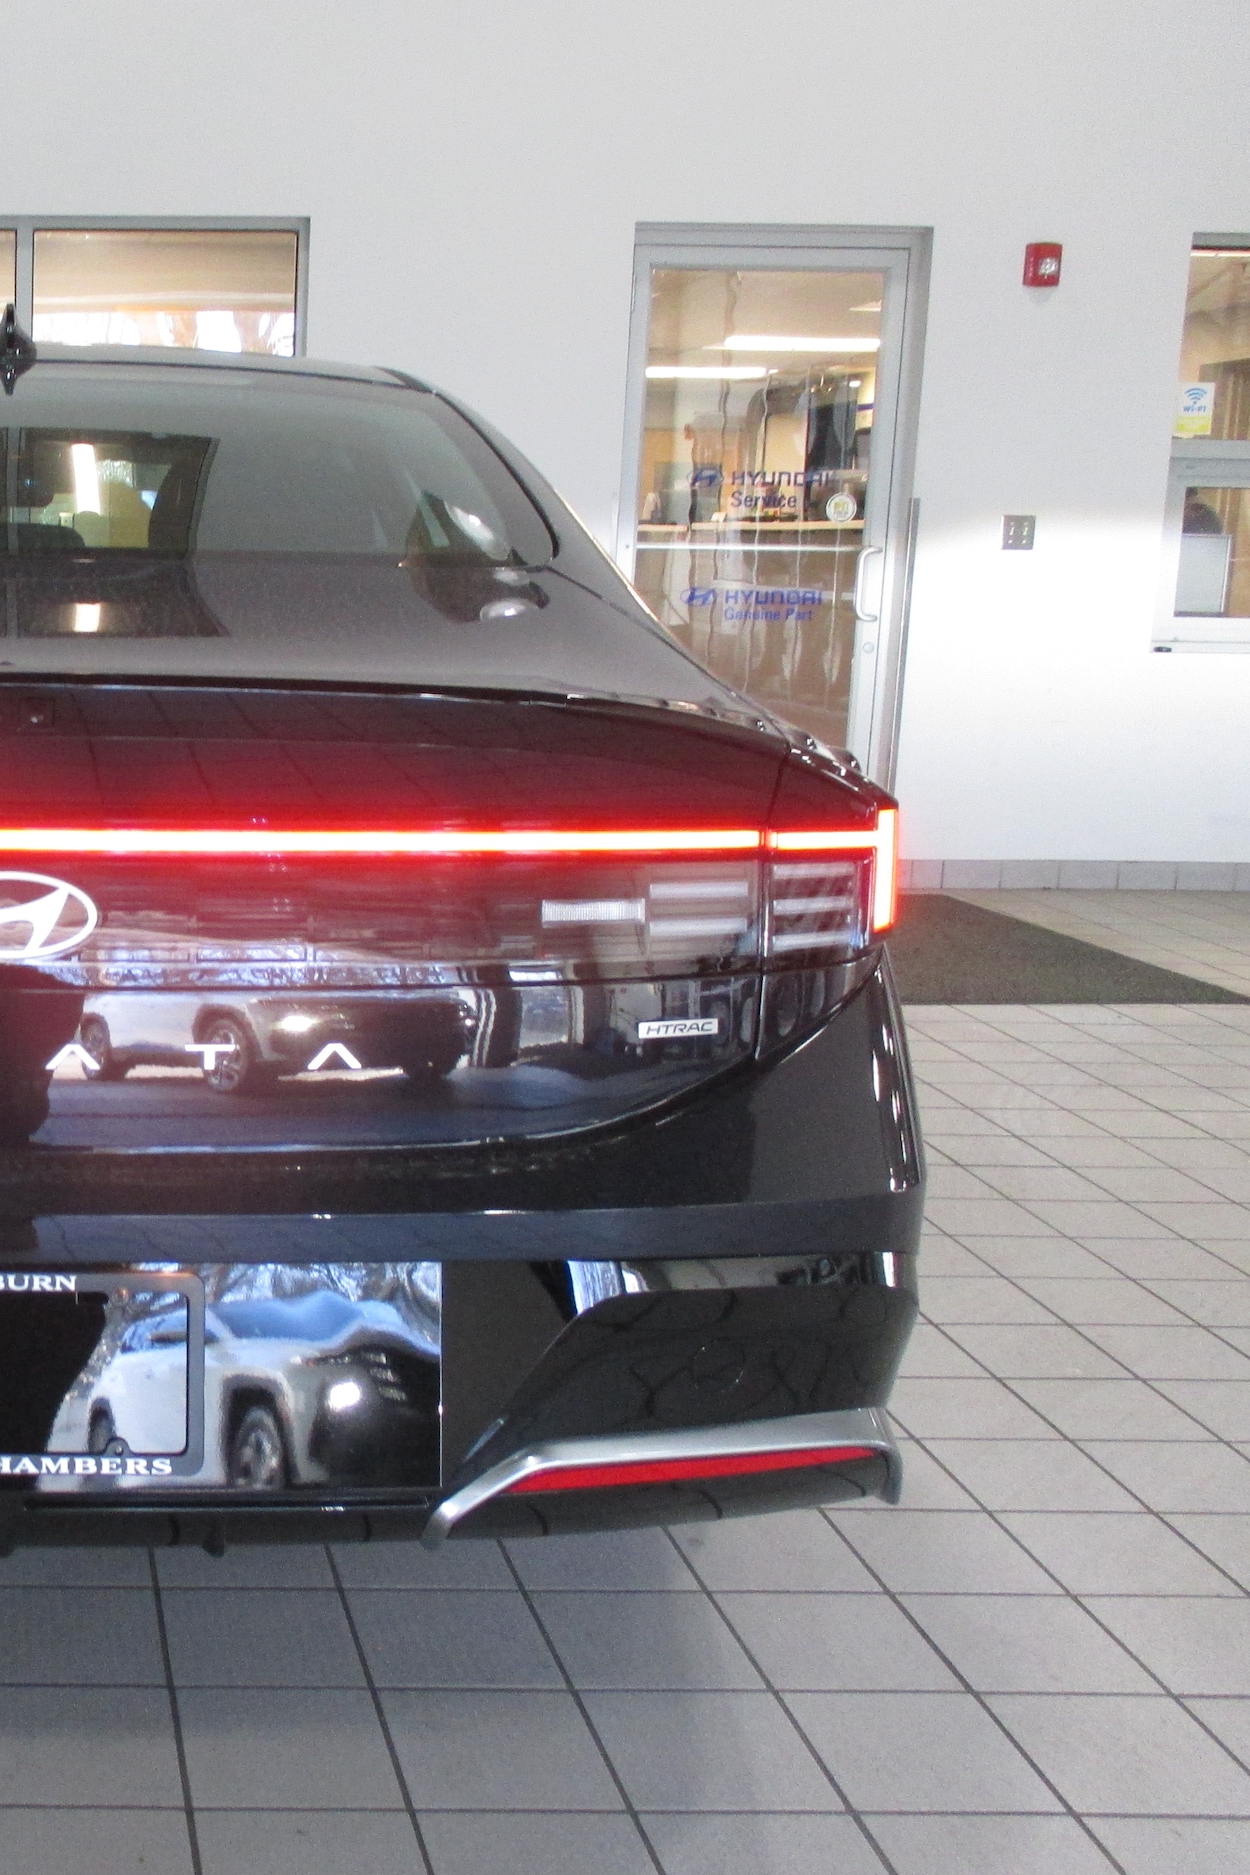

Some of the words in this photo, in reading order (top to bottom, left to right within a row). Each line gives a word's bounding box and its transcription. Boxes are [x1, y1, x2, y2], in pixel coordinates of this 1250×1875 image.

[732, 471, 830, 487] HYUNDAI
[731, 490, 798, 508] Service
[725, 589, 822, 605] HYUNDAI
[724, 606, 781, 621] Genuine
[645, 1020, 713, 1036] HTRAC
